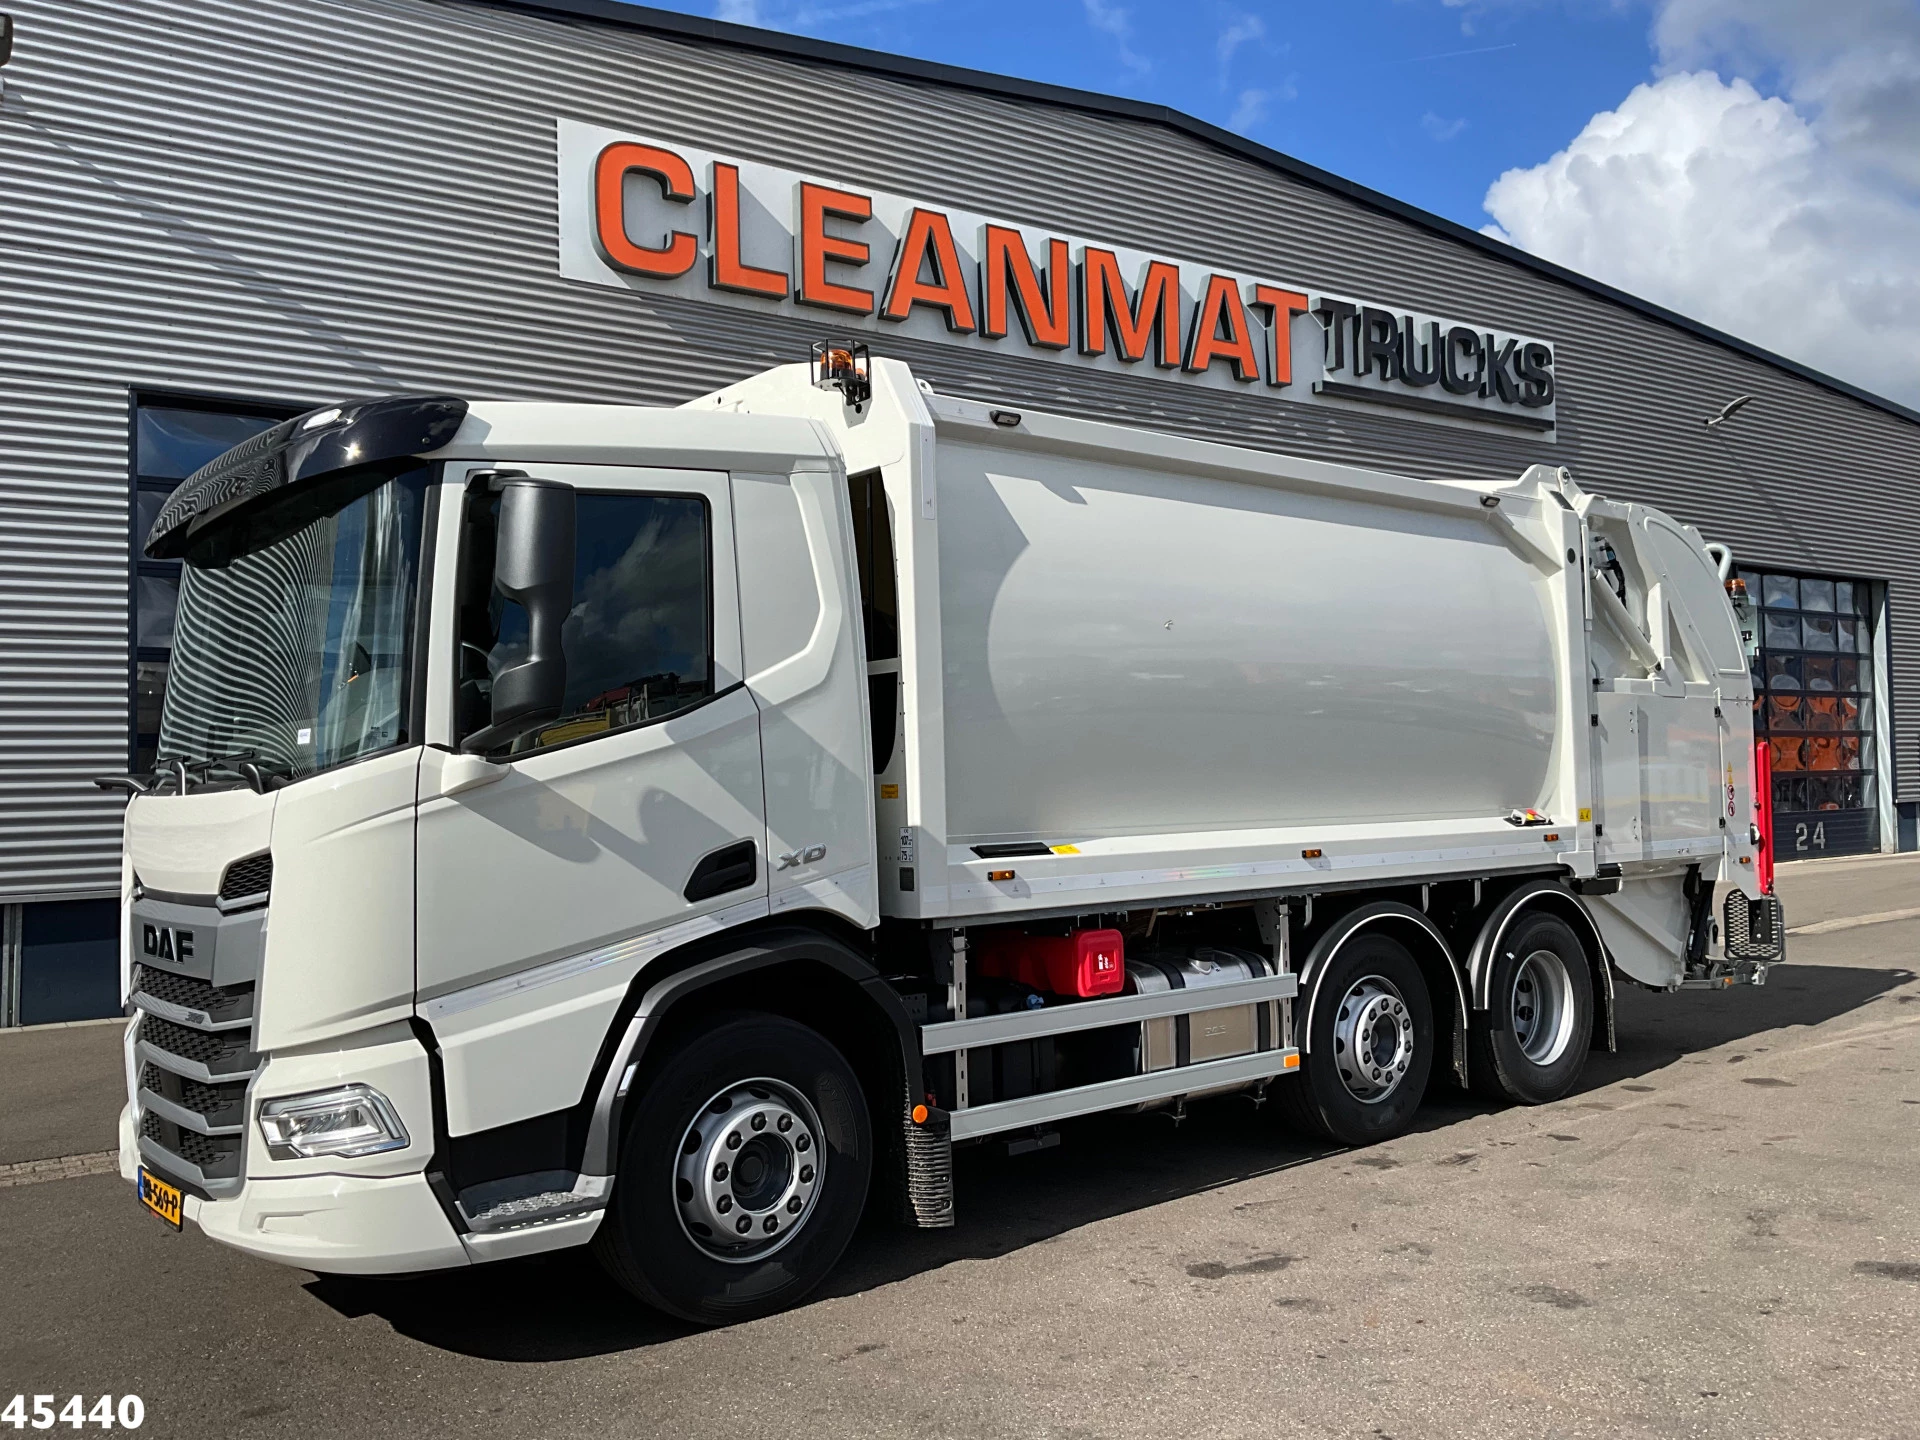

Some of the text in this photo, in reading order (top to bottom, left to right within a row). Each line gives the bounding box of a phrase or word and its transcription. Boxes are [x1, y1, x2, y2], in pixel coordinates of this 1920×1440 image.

[594, 140, 1554, 407] CLEANMAT TRUCKS
[1795, 821, 1826, 851] 24
[777, 843, 827, 872] XD
[143, 923, 195, 965] DAF
